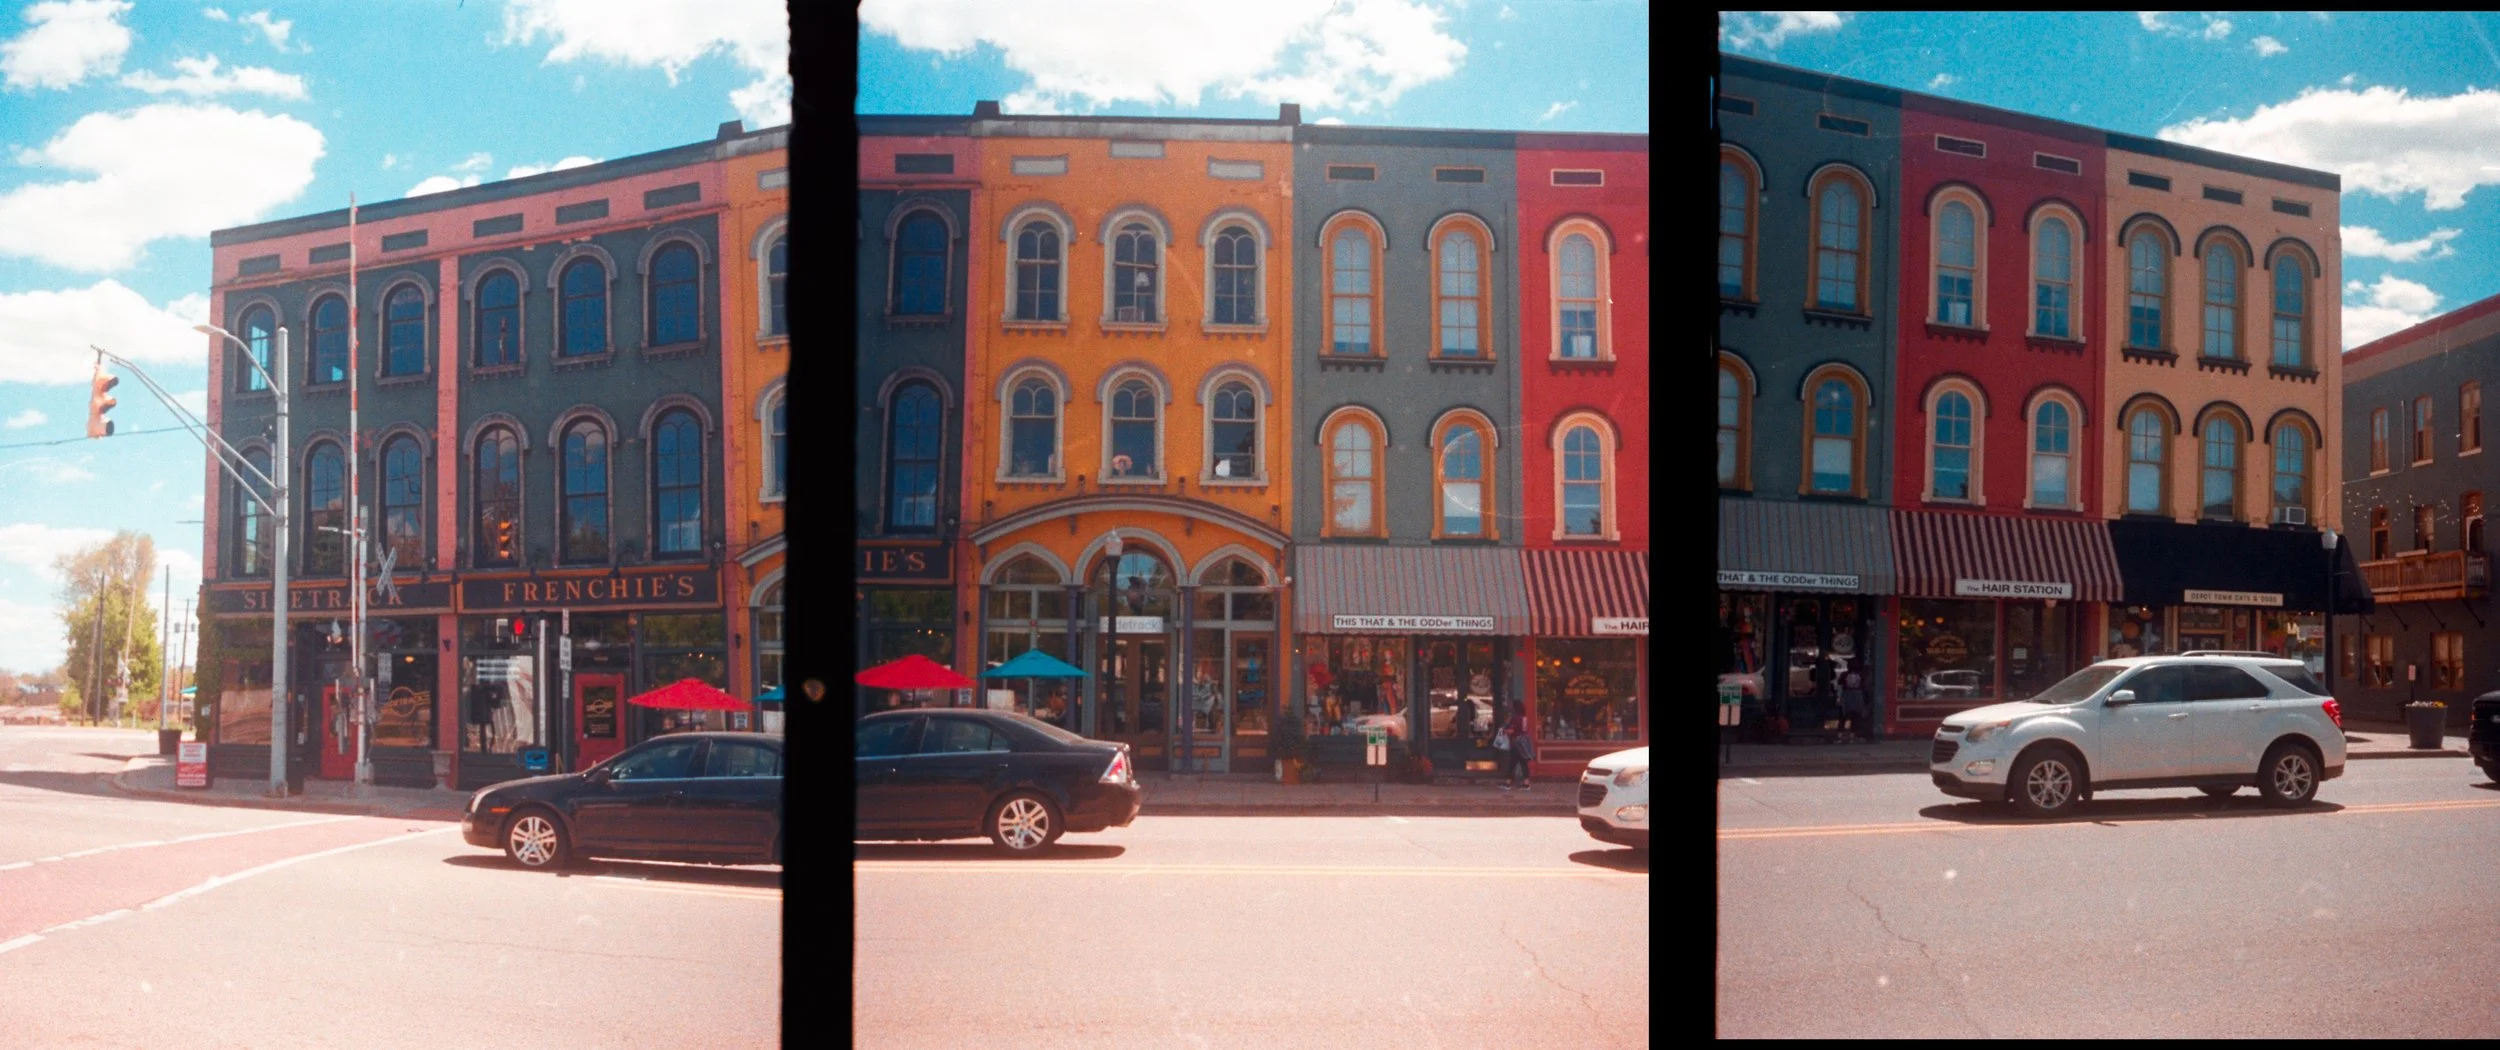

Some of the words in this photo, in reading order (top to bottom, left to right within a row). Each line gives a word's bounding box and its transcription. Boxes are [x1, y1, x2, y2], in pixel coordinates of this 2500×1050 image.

[1719, 572, 1744, 582] THAT
[1748, 573, 1756, 582] &
[1760, 574, 1780, 583] THE
[1783, 575, 1817, 585] ODDer
[1820, 576, 1857, 586] THINGS
[503, 573, 695, 602] FRENCHIE'S
[1982, 583, 2010, 593] HAIR
[2014, 584, 2063, 595] STATION
[242, 587, 404, 609] SIETRCK
[1336, 617, 1357, 626] THIS
[1360, 617, 1384, 626] THAT
[1388, 618, 1395, 627] &
[1398, 618, 1417, 627] THE
[1420, 618, 1452, 628] ODDer
[1455, 619, 1492, 628] THINGS
